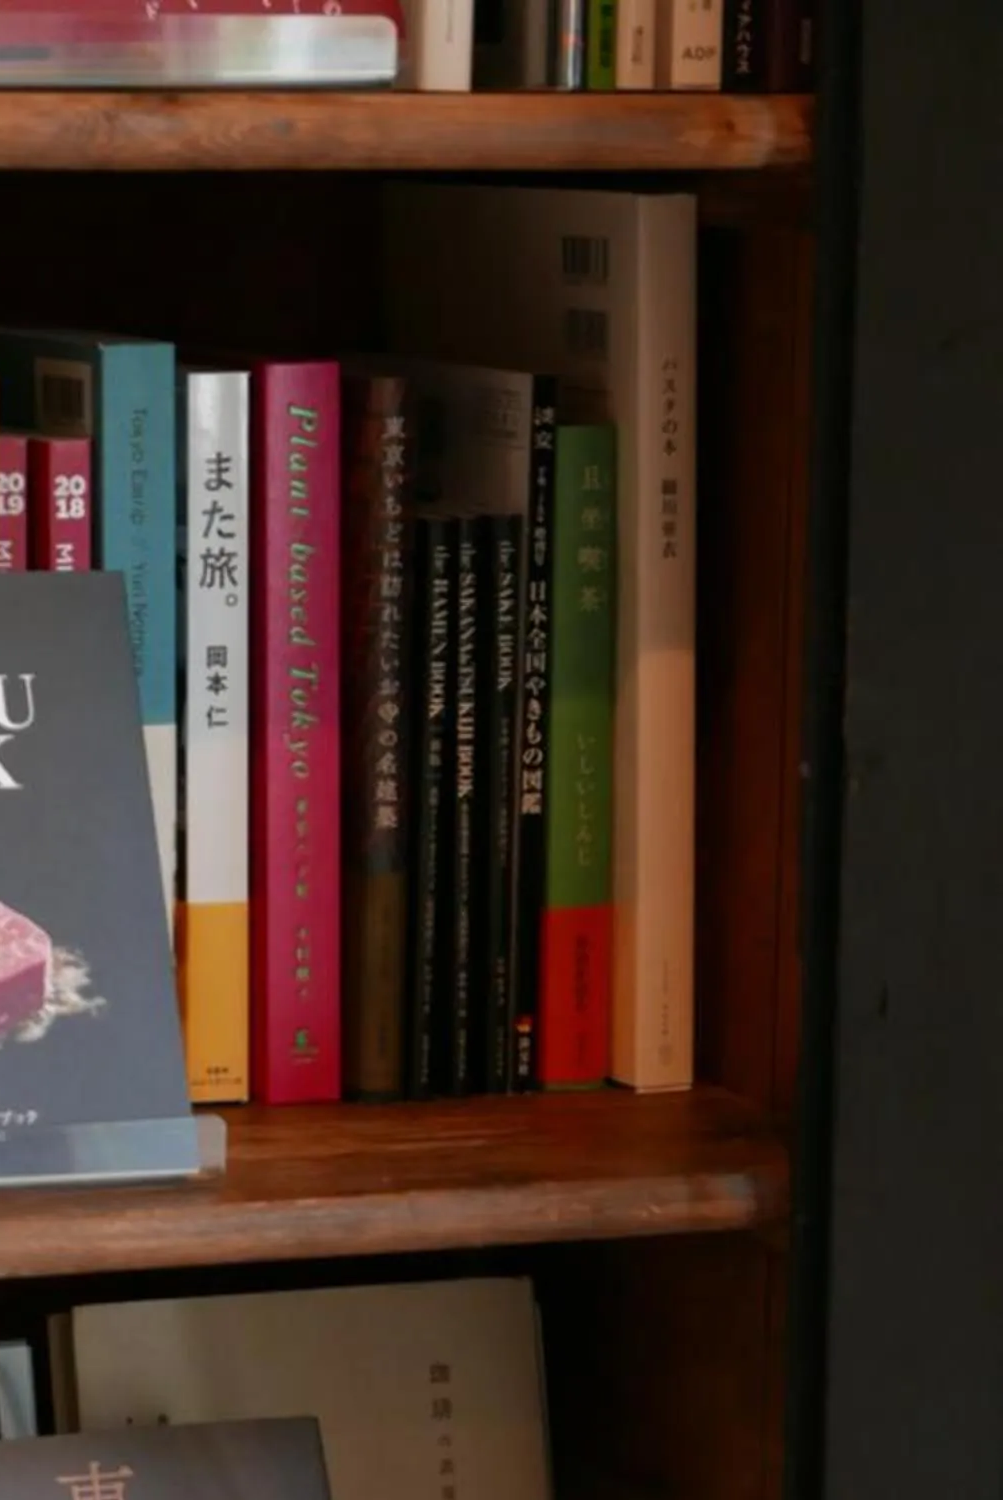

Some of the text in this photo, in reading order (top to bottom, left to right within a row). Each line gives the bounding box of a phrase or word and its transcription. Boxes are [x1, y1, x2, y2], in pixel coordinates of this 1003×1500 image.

[53, 474, 86, 497] 20
[54, 498, 86, 519] 18
[199, 452, 239, 607] また旅。
[287, 542, 317, 647] based
[205, 645, 229, 729] 岡本仁
[283, 661, 320, 779] Tokyo
